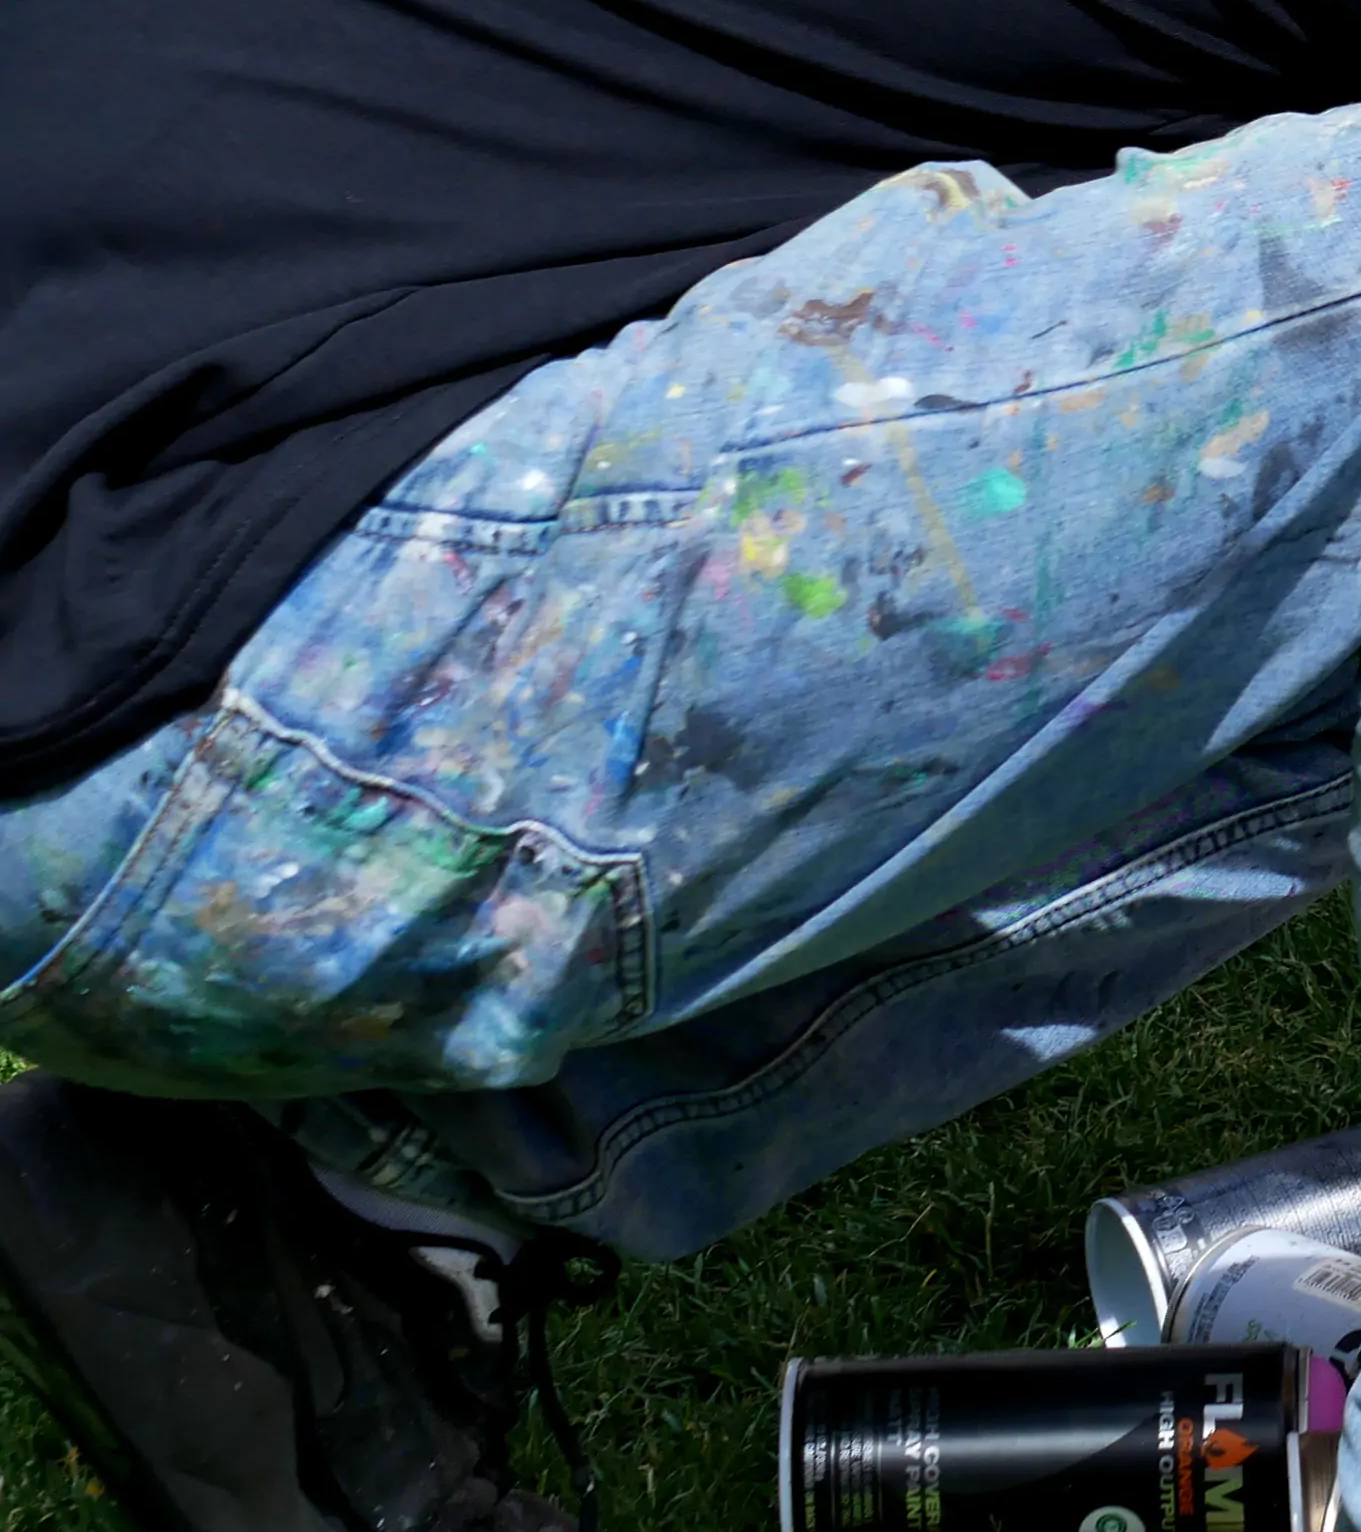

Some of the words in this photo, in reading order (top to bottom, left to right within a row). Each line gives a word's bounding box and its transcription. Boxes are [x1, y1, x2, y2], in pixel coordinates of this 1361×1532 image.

[1157, 1390, 1175, 1450] HIGH
[904, 1464, 922, 1531] PAINT
[923, 1445, 940, 1532] COVER
[1157, 1454, 1176, 1532] OUTPU
[1176, 1416, 1195, 1516] ORANGE
